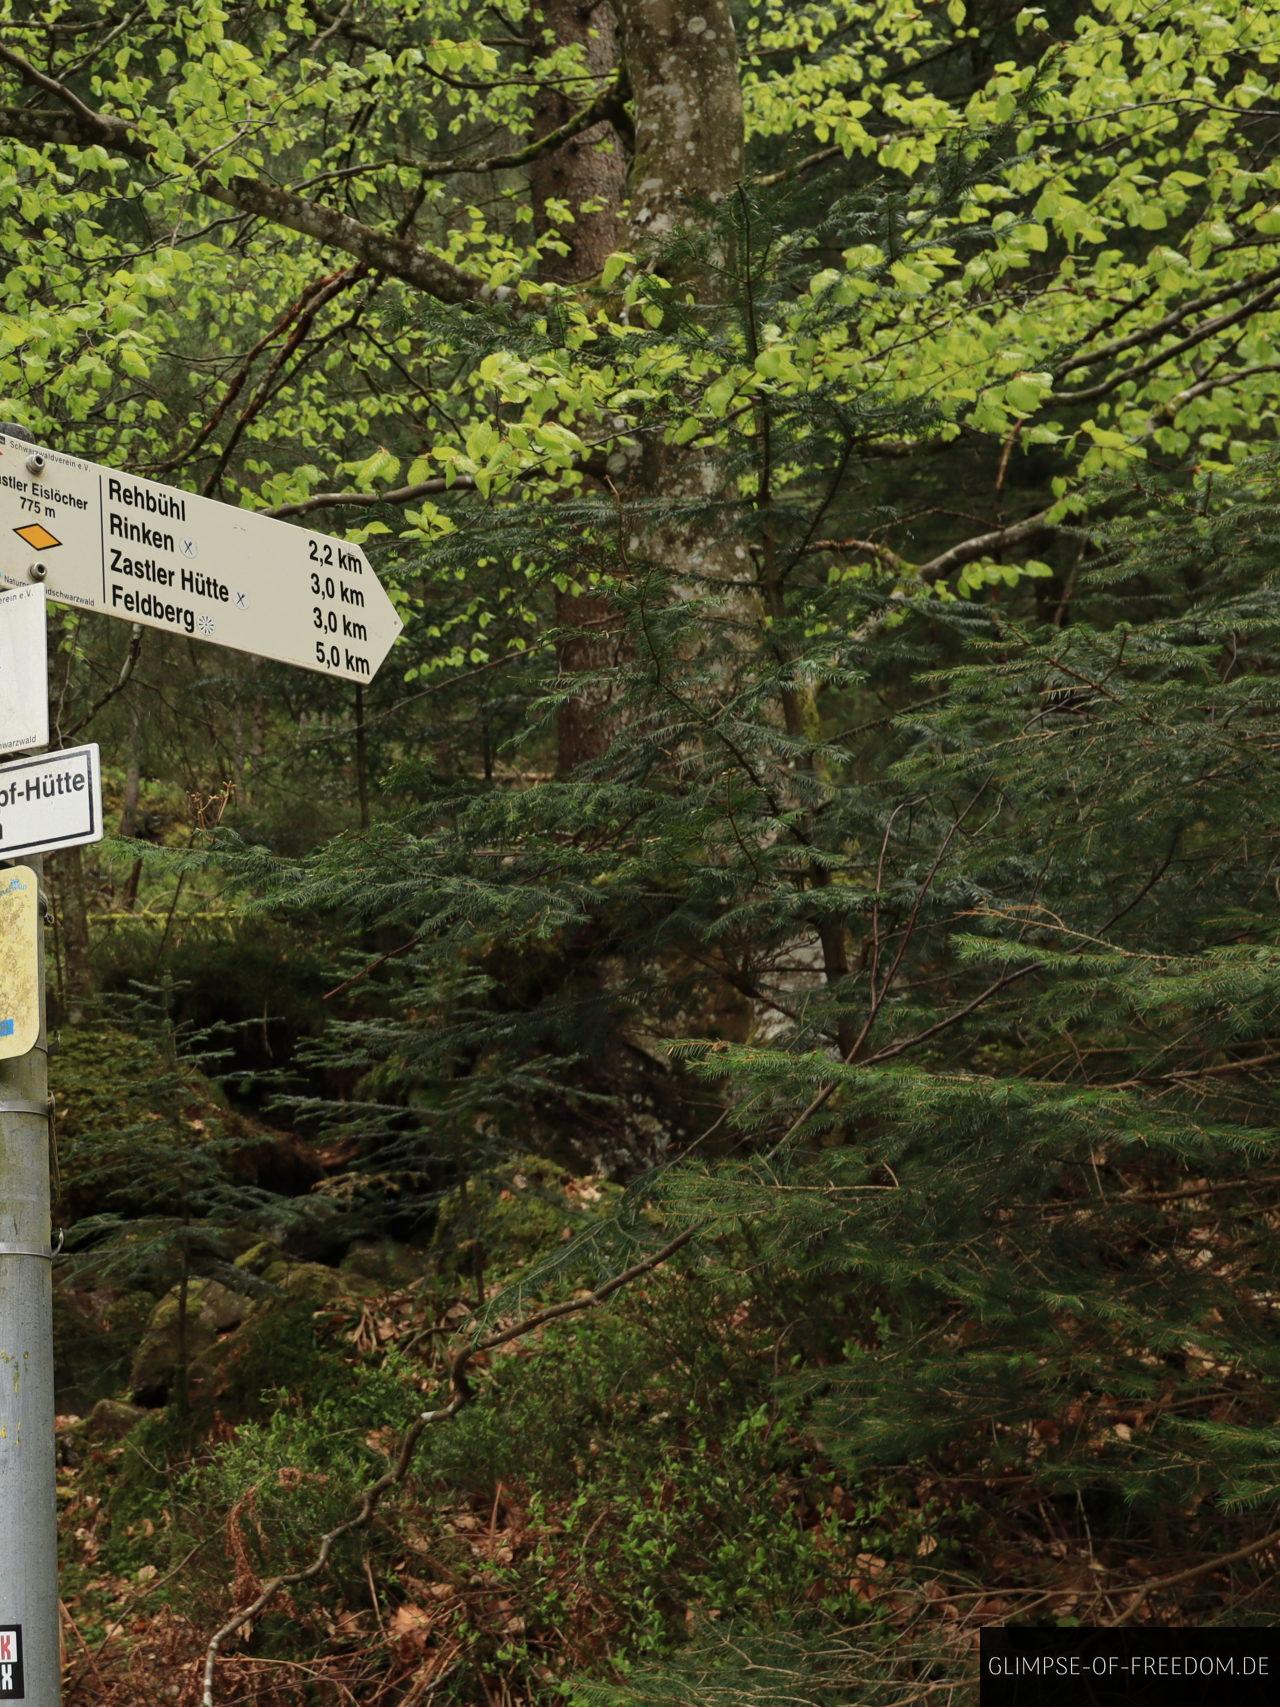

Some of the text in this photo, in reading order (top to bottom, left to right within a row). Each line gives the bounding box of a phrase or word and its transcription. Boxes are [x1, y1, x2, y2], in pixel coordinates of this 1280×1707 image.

[20, 497, 55, 518] 775 m
[32, 483, 88, 510] Eislöcher
[109, 478, 363, 575] Rehbühl 2,2 km
[109, 513, 365, 607] Rinken 3,0 km
[110, 549, 368, 642] Zastler Hütte 3,0 km
[112, 584, 370, 676] Feldberg 5,0 km
